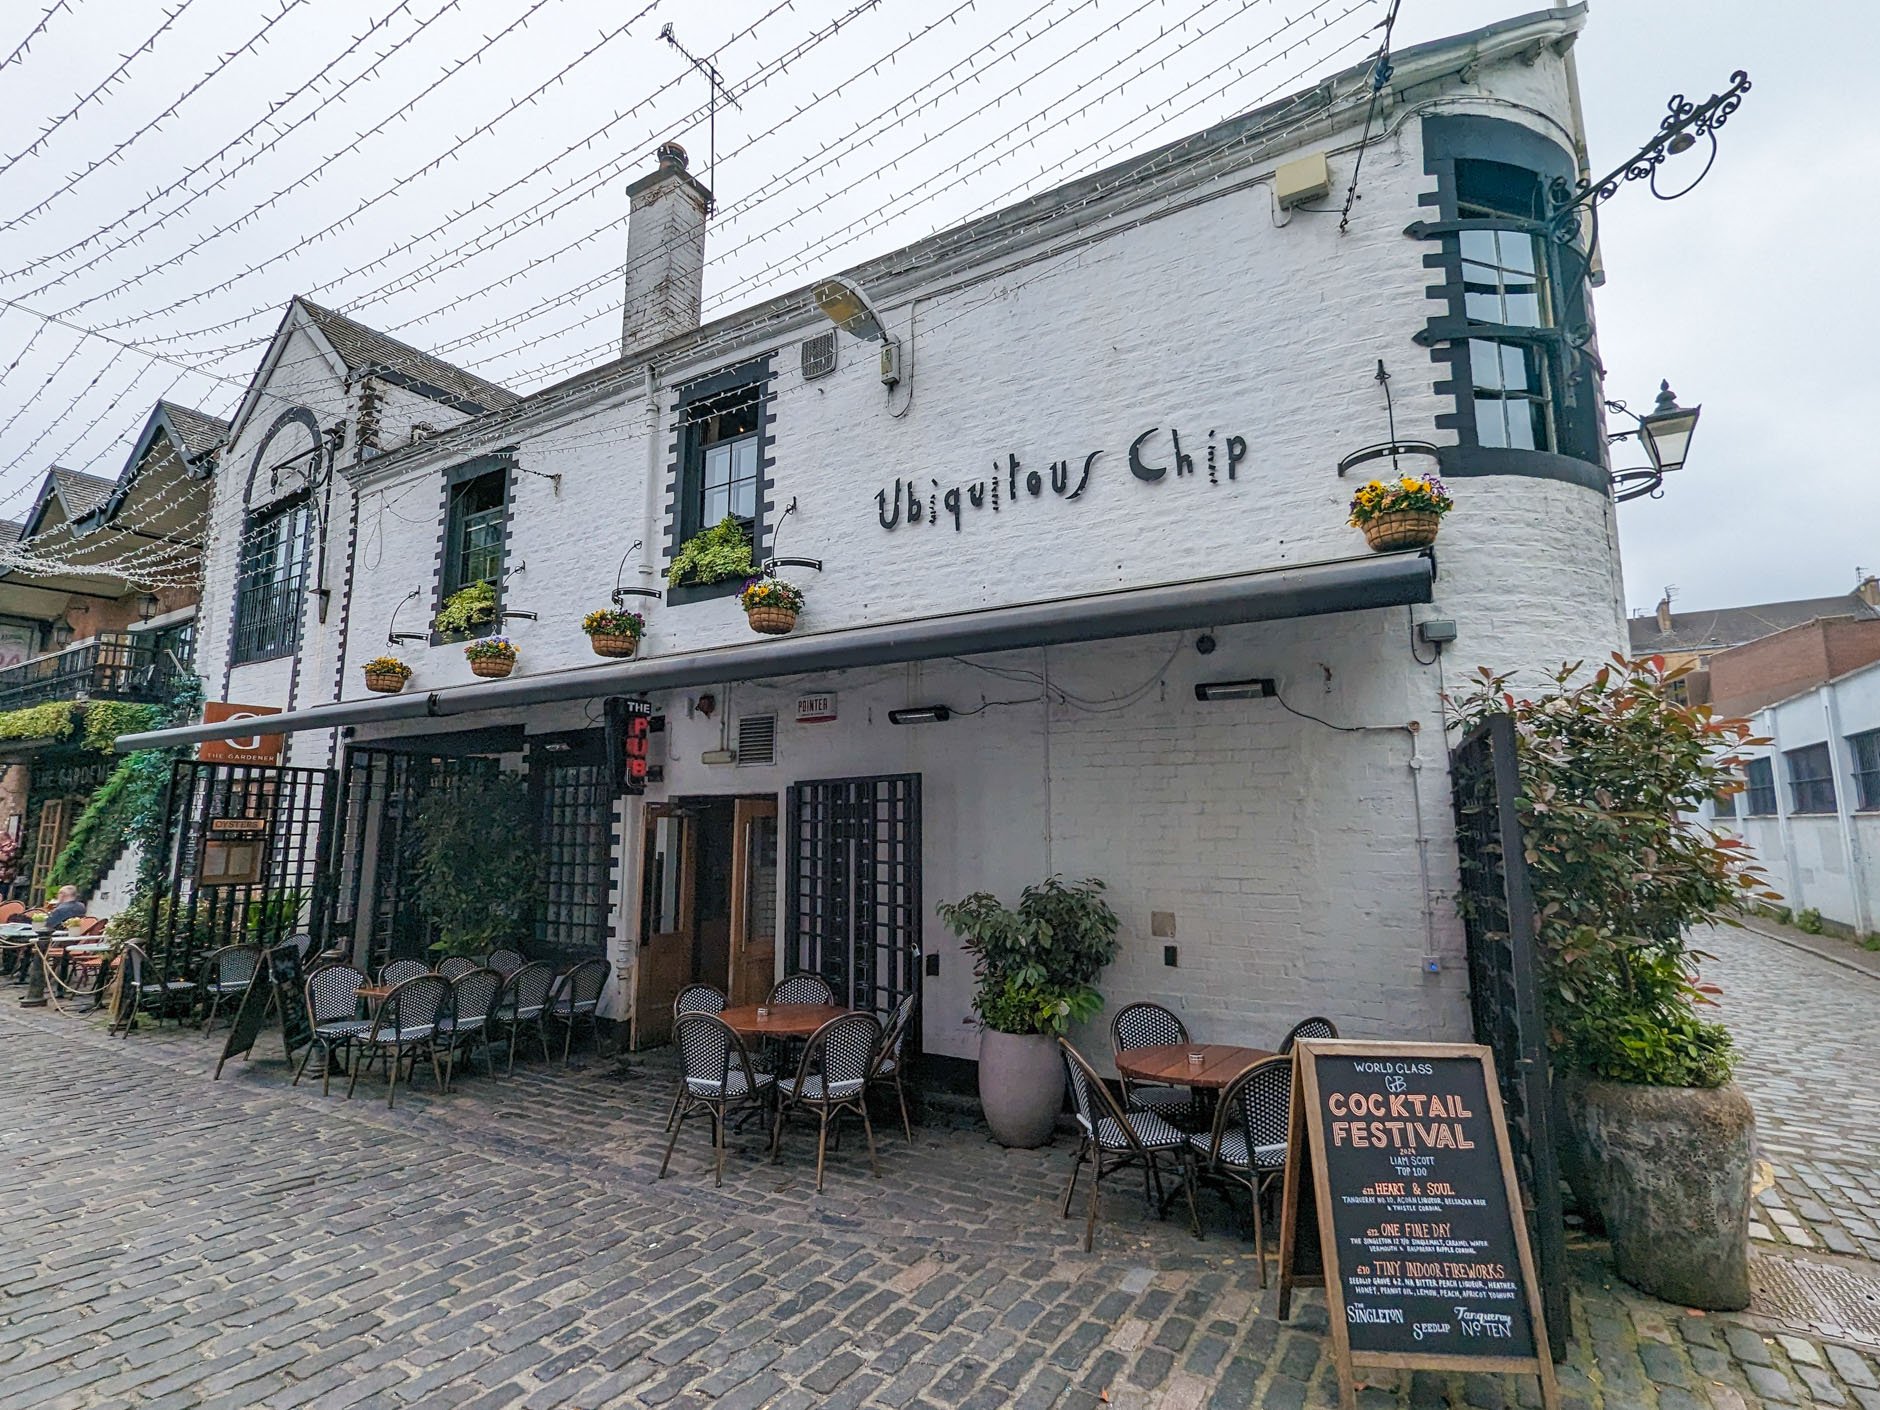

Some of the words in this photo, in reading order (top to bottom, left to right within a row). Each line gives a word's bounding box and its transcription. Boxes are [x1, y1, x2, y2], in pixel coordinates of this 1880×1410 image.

[874, 450, 1104, 531] Ubiquitous
[1128, 428, 1247, 484] Chip
[627, 701, 651, 714] THE
[798, 698, 828, 713] POINTER
[626, 716, 649, 777] PUB
[227, 753, 275, 761] GARDENER
[1354, 1062, 1393, 1073] WORLD
[1395, 1063, 1433, 1075] CLASS
[1328, 1092, 1472, 1118] COCKTAIL
[1332, 1121, 1475, 1149] FESTIVAL
[1390, 1156, 1409, 1166] LIAM
[1411, 1156, 1435, 1166] SCOTT
[1395, 1166, 1410, 1176] TOP
[1413, 1167, 1427, 1177] 100
[1375, 1182, 1406, 1196] HEART
[1412, 1182, 1422, 1196] &
[1426, 1182, 1456, 1196] SOUL
[1342, 1196, 1375, 1204] TANQUERAY
[1380, 1223, 1401, 1236] ONE
[1405, 1223, 1430, 1238] FINE
[1431, 1223, 1451, 1238] DAY
[1357, 1265, 1370, 1275] £10
[1373, 1261, 1401, 1276] TINY
[1406, 1261, 1443, 1278] INDOOR
[1443, 1263, 1505, 1279] FIREWORKS
[1349, 1277, 1371, 1285] SEEDLIP
[1416, 1278, 1438, 1287] BITTER
[1439, 1279, 1457, 1287] PEACH
[1462, 1290, 1488, 1298] APRICOT
[1347, 1305, 1404, 1324] SINGLETON
[1454, 1306, 1512, 1326] Tanqueray
[1413, 1323, 1451, 1341] SEEDLIP
[1486, 1323, 1512, 1338] TEN
